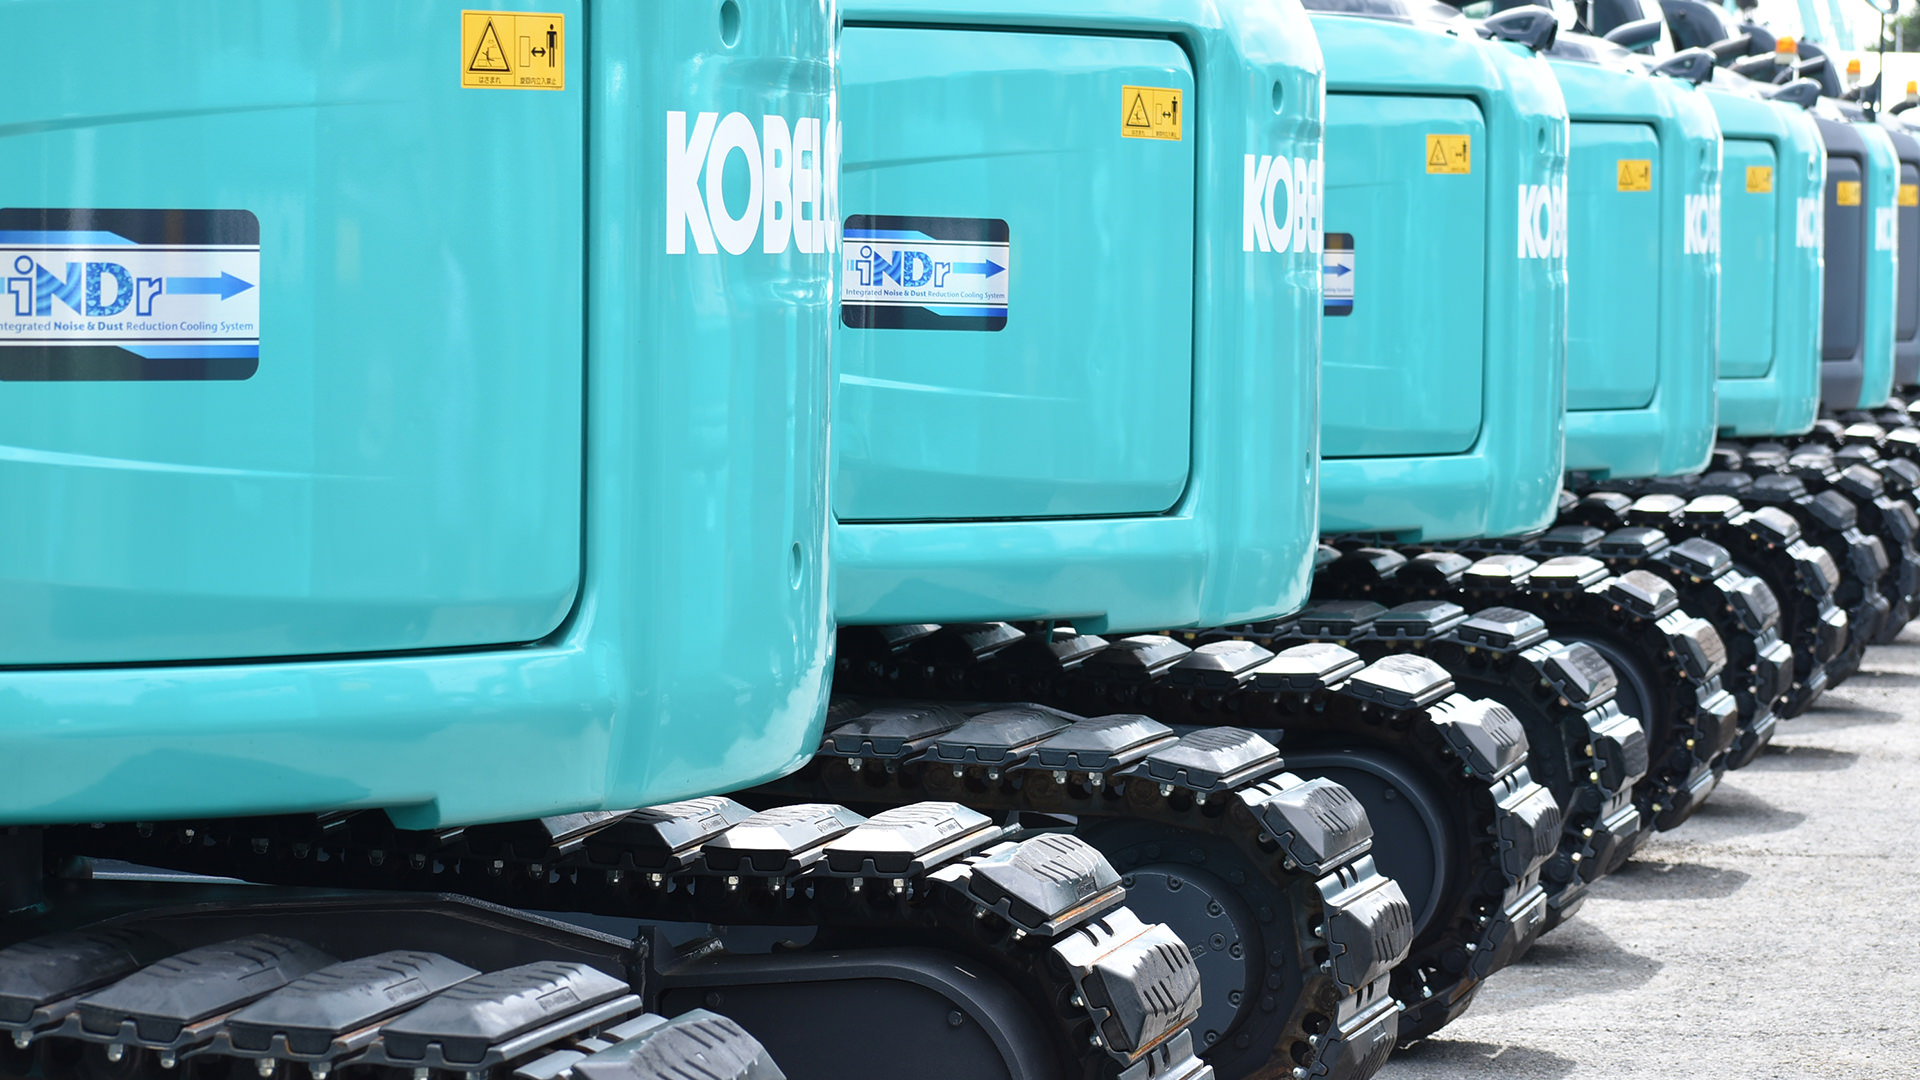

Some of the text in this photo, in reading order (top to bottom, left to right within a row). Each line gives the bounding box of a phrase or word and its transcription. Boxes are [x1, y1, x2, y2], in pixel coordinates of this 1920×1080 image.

[855, 245, 950, 288] iNDr
[8, 255, 162, 317] iNDr
[845, 288, 882, 298] Integrated
[884, 289, 903, 297] Noise
[911, 290, 927, 298] Dust
[928, 290, 959, 299] Reduction
[960, 291, 983, 301] Cooling
[984, 292, 1005, 301] System
[53, 321, 85, 331] Noise
[87, 321, 96, 331] &
[97, 321, 124, 331] Dust
[126, 320, 178, 331] Reduction
[180, 320, 218, 334] Cooling
[220, 320, 254, 334] System
